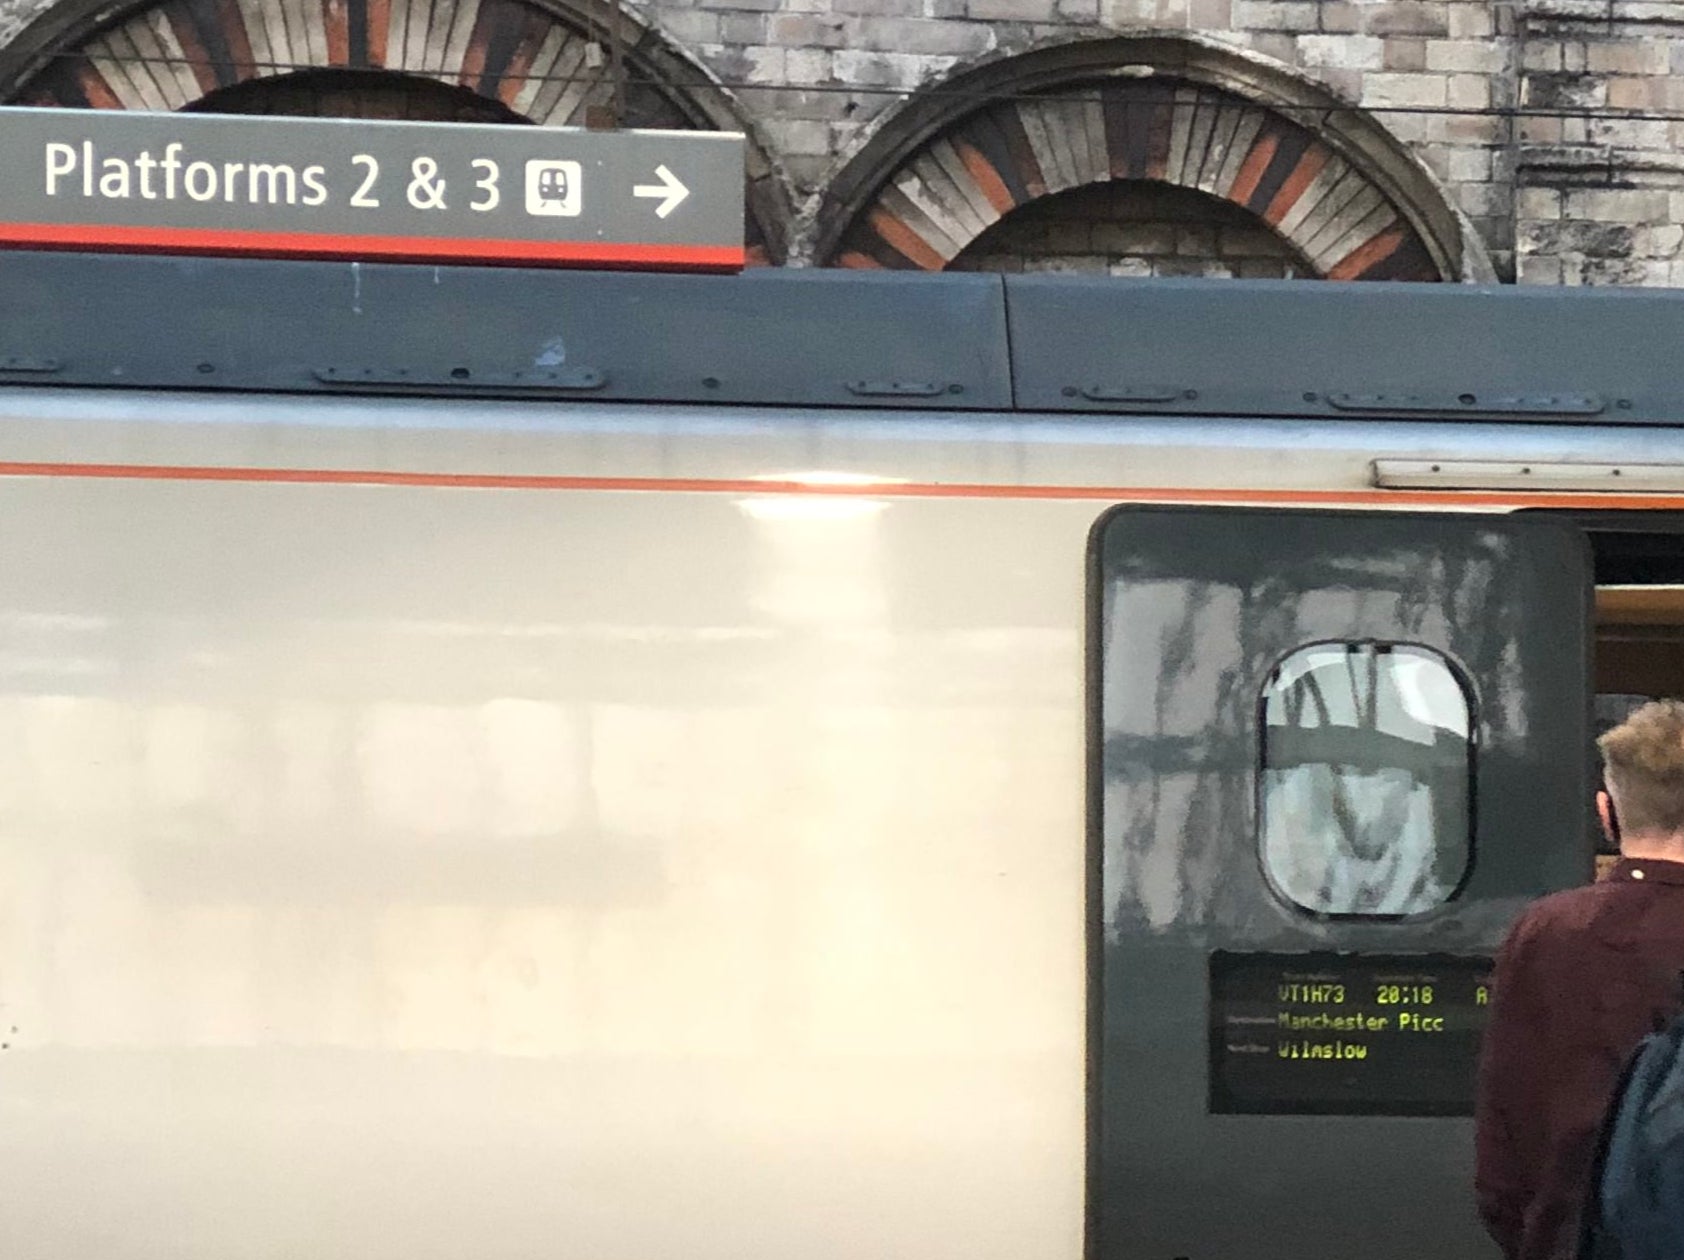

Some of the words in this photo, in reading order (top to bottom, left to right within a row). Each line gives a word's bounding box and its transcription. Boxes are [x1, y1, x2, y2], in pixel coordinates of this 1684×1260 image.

[45, 140, 329, 206] Platforms
[350, 154, 381, 208] 2
[406, 157, 448, 211] &
[470, 159, 501, 213] 3
[1376, 985, 1434, 1005] 20:18
[1278, 1011, 1388, 1029] Manchester
[1399, 1011, 1445, 1032] Picc
[1278, 1040, 1368, 1059] Wilmslow
